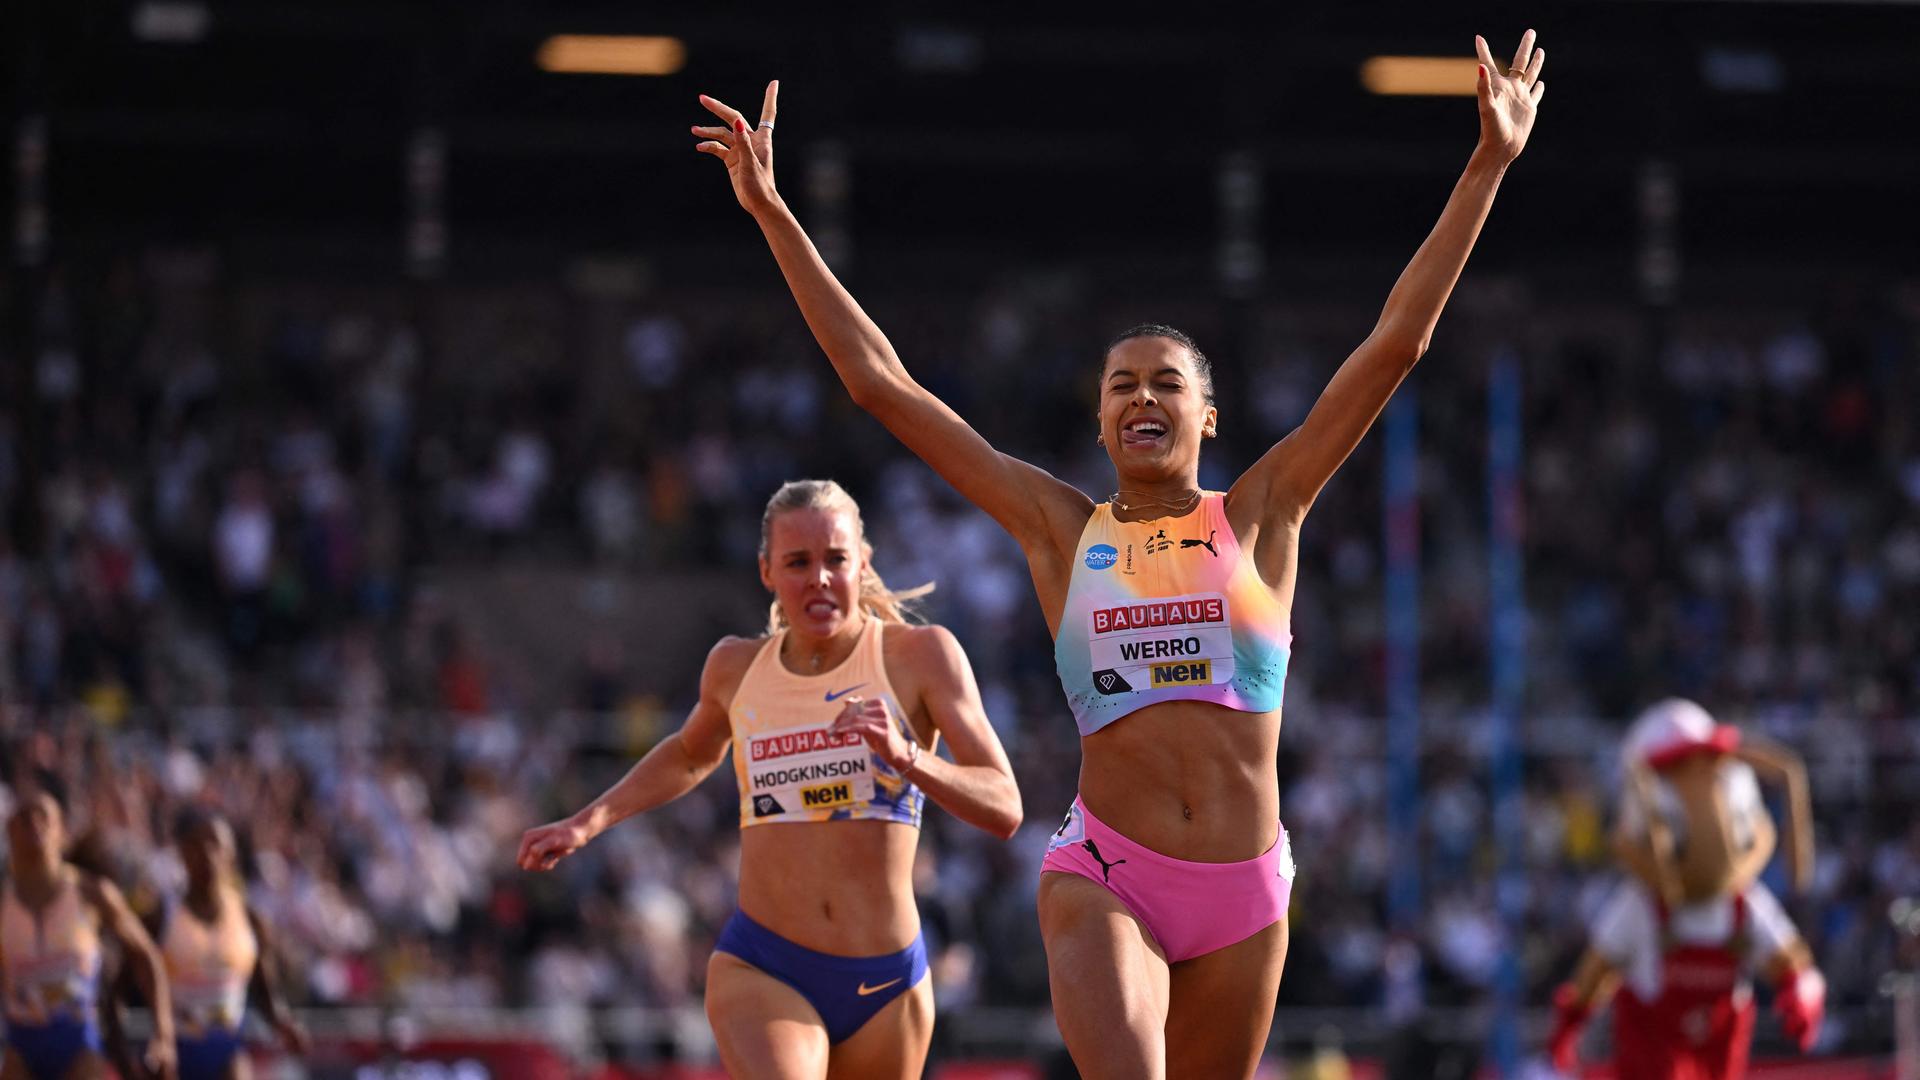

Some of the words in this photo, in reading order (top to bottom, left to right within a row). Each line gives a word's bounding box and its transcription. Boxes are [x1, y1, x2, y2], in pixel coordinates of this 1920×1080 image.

[1084, 552, 1120, 561] FOCUS
[1095, 601, 1221, 631] BAUHAUS
[1120, 637, 1201, 661] WERRO
[753, 758, 866, 789] HODGKINSON
